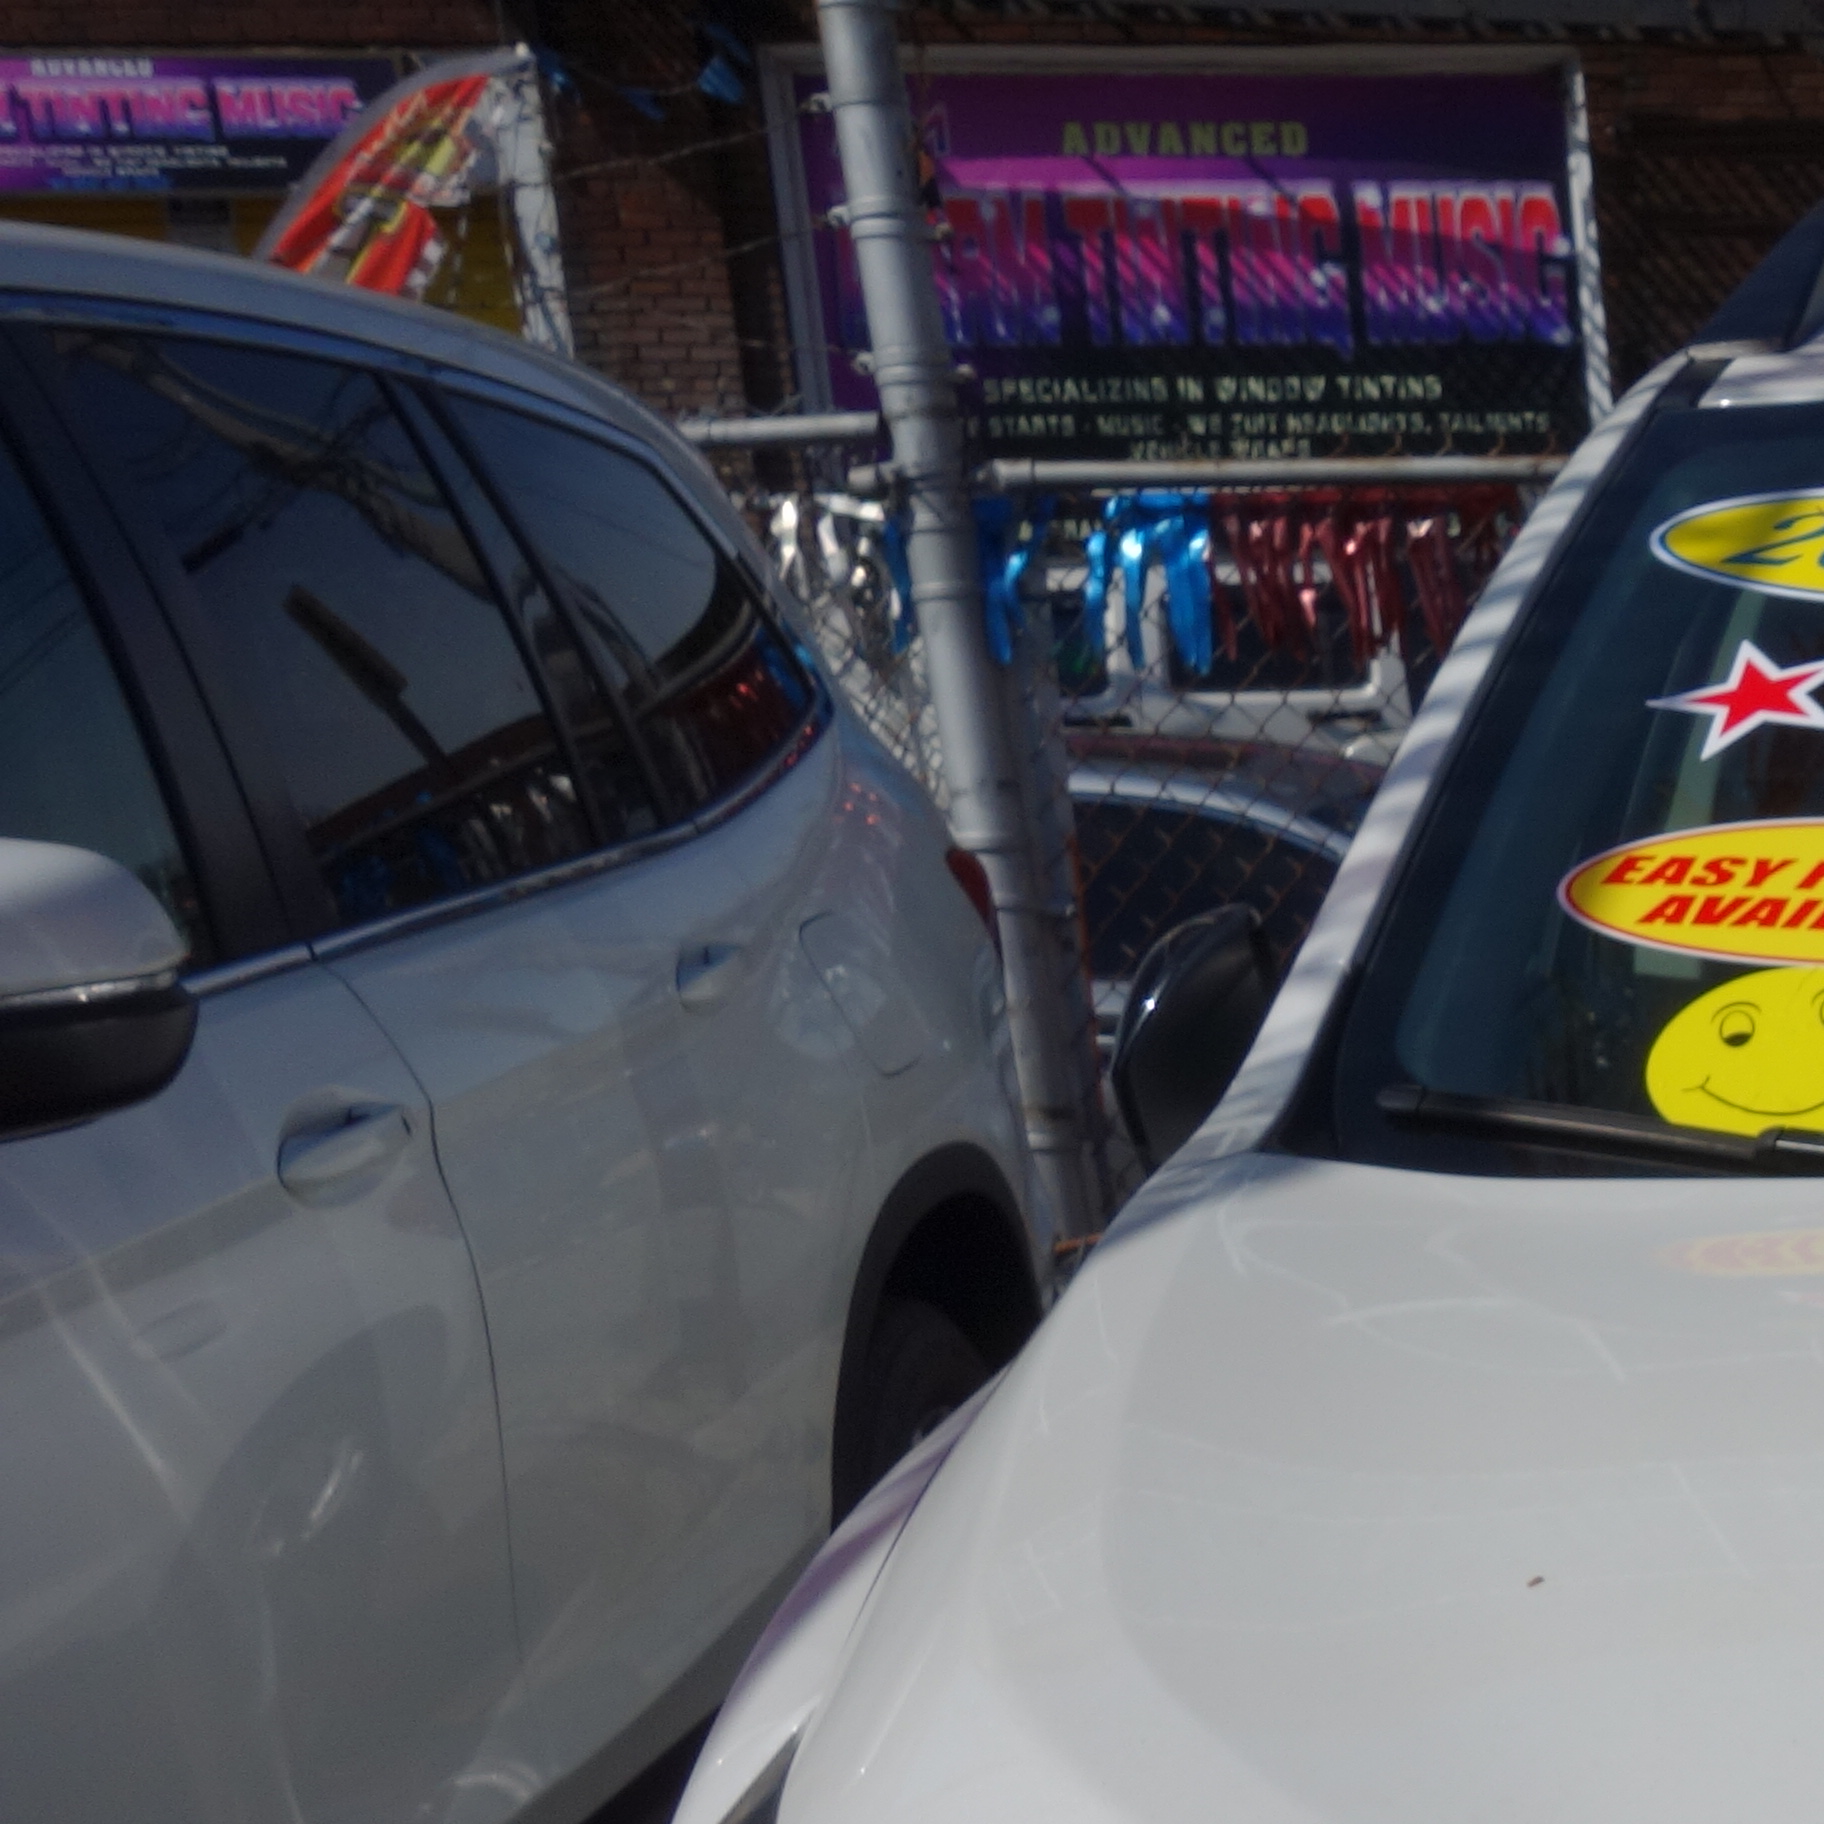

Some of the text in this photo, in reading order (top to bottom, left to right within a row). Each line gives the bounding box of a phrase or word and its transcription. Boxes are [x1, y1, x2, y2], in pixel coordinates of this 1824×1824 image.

[212, 76, 365, 138] MUSIC
[1062, 120, 1308, 157] ADVANCED
[1063, 180, 1354, 359] TINTING
[1351, 180, 1571, 346] MUSIC
[1175, 375, 1205, 403] IN
[1601, 855, 1795, 890] EASY
